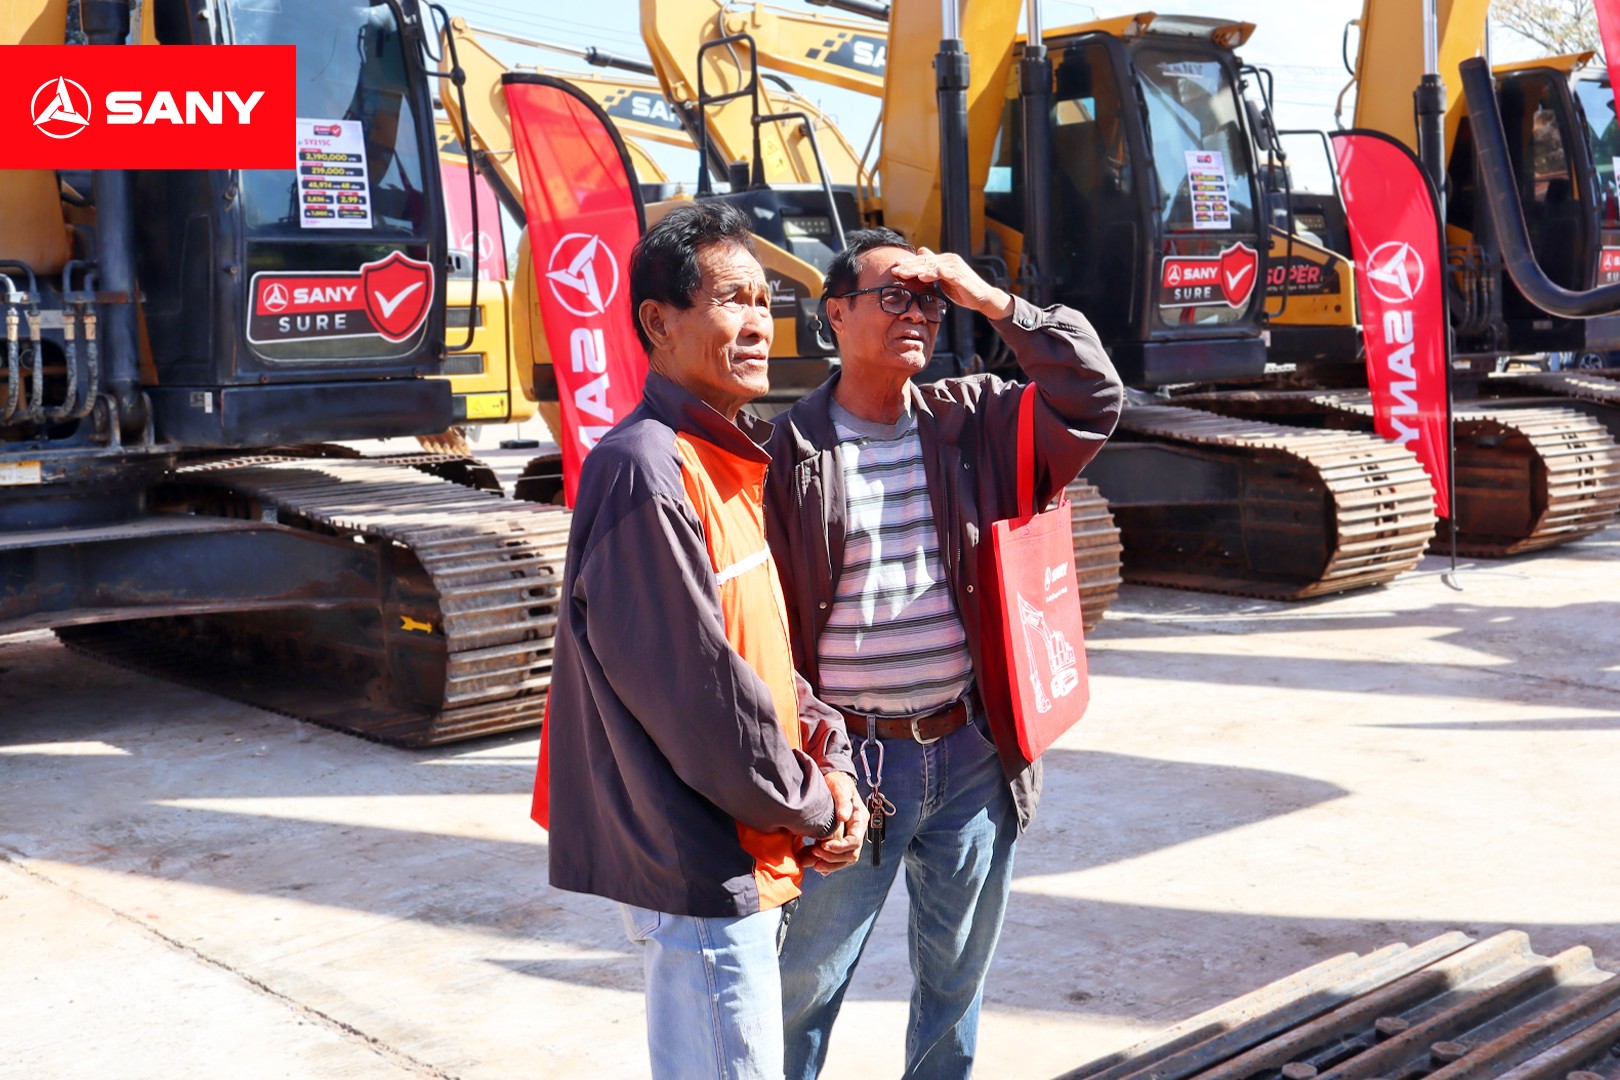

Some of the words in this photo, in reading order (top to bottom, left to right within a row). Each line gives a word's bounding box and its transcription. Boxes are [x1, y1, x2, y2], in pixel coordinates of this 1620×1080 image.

[305, 152, 348, 162] 2,190,000
[311, 166, 345, 175] 219,000
[1183, 266, 1218, 281] SANY
[292, 285, 358, 305] SANY
[1174, 286, 1212, 301] SURE
[278, 313, 347, 333] SURE
